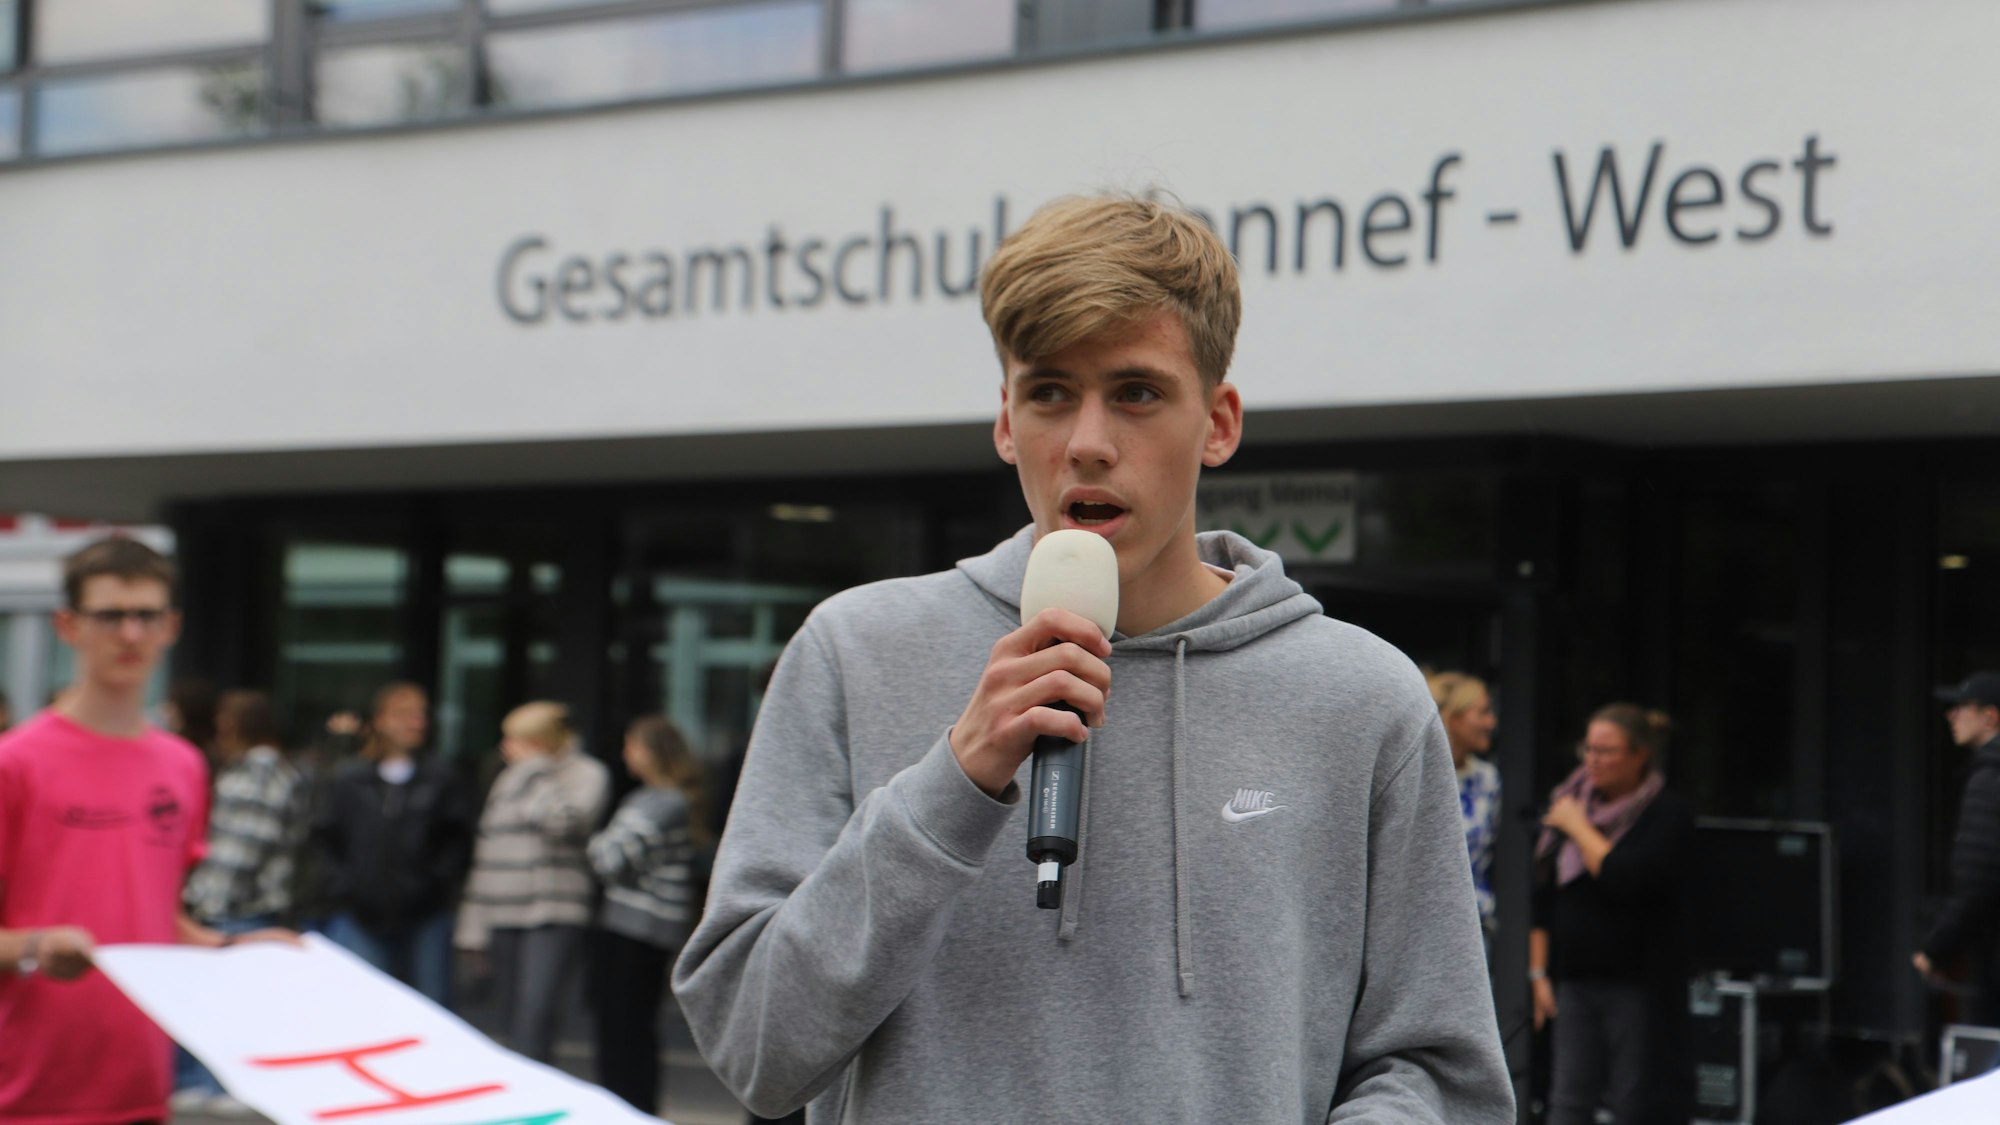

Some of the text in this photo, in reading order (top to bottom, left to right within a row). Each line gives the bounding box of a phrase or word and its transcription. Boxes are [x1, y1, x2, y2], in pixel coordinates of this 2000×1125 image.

[497, 194, 1006, 324] Gesamtschul
[1180, 153, 1462, 274] nnef
[1553, 135, 1836, 254] West
[1049, 782, 1058, 829] SENNHEISER
[1232, 788, 1275, 810] NIKE
[246, 1036, 509, 1120] H
